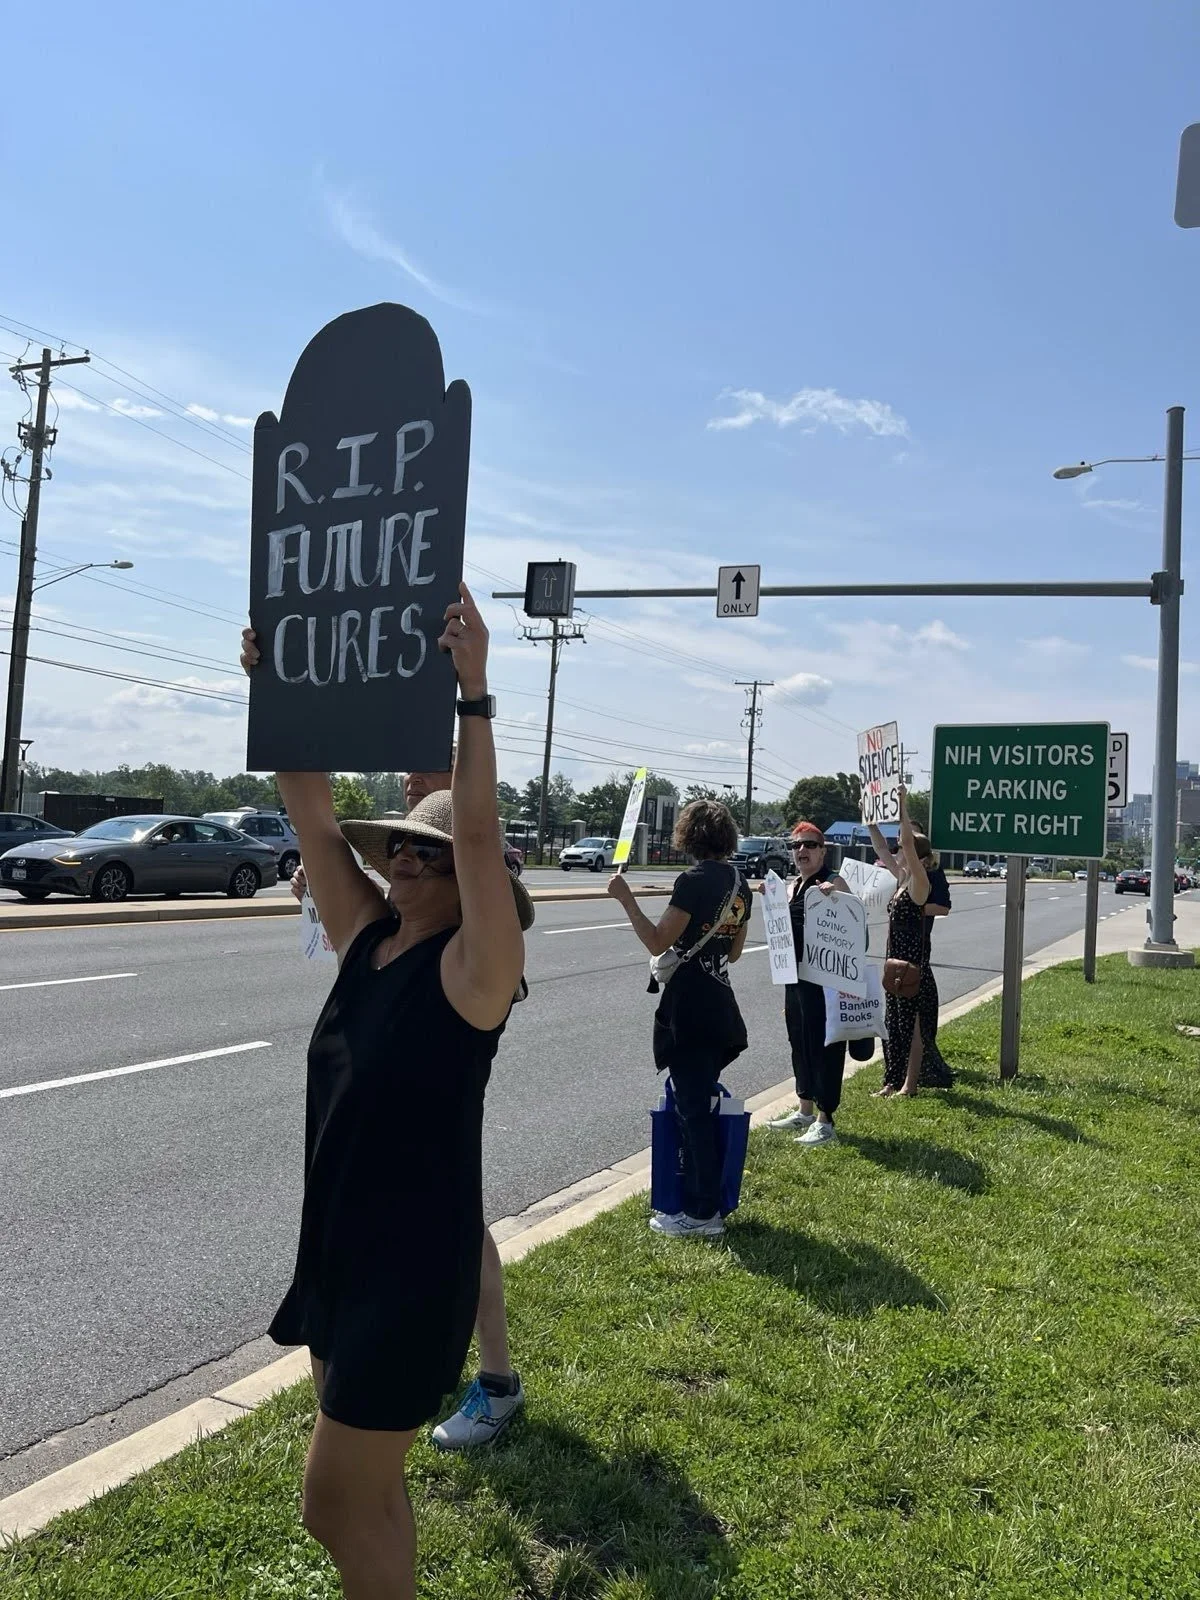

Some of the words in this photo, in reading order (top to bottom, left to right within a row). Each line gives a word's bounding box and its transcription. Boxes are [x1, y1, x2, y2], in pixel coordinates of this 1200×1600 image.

[276, 420, 435, 514] R.I.P.
[265, 508, 439, 599] FUTURE
[534, 599, 562, 611] ONLY
[722, 602, 752, 614] ONLY
[273, 603, 427, 686] CURES
[866, 728, 883, 753] NO
[945, 745, 981, 765] NIH
[989, 744, 1094, 766] VISITORS
[859, 744, 899, 790] SCIENCE
[869, 780, 882, 796] NO
[967, 779, 1067, 801] PARKING
[862, 787, 899, 823] CURES
[950, 812, 1006, 833] NEXT
[1013, 814, 1083, 836] RIGHT
[843, 862, 882, 888] SAVE
[826, 908, 838, 918] IN
[816, 917, 847, 934] LOVING
[816, 931, 855, 950] MEMORY
[806, 943, 859, 981] VACCINES
[839, 999, 880, 1011] Banning
